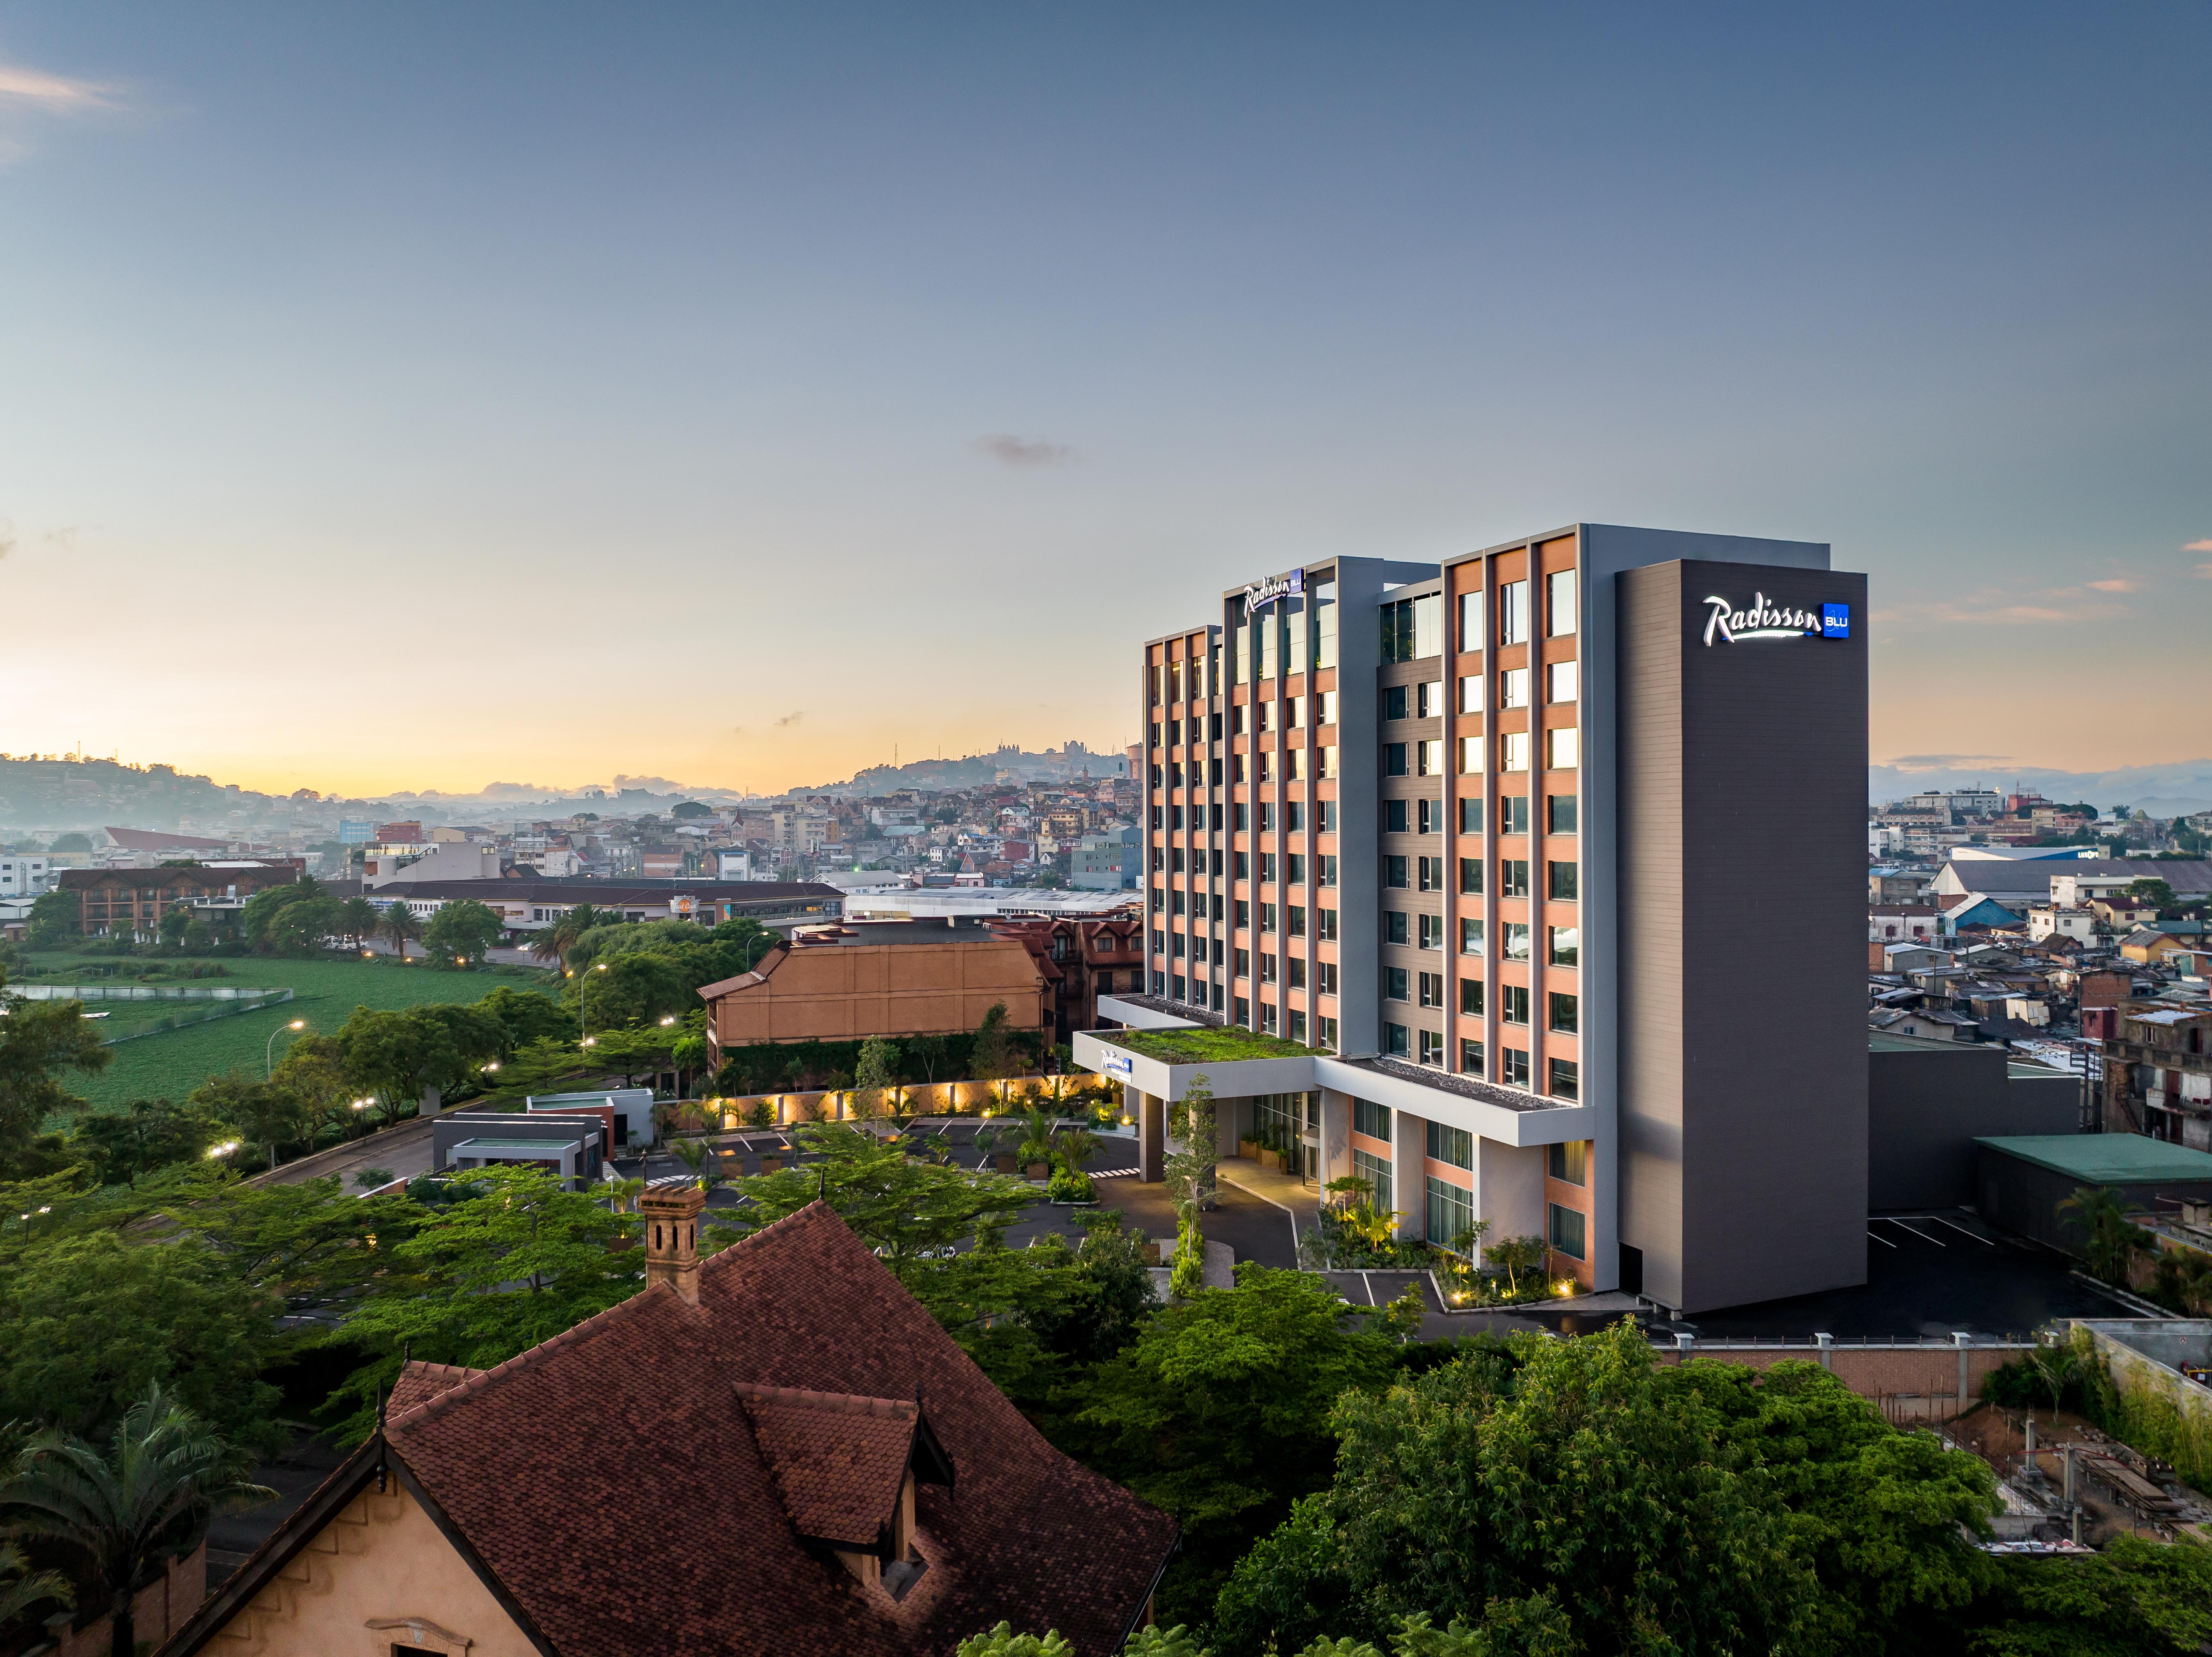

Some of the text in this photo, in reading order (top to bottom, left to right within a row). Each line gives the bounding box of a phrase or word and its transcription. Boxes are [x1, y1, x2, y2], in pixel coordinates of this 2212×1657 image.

[1244, 576, 1301, 618] Radisson BLU
[1703, 592, 1847, 647] Radisson BLU
